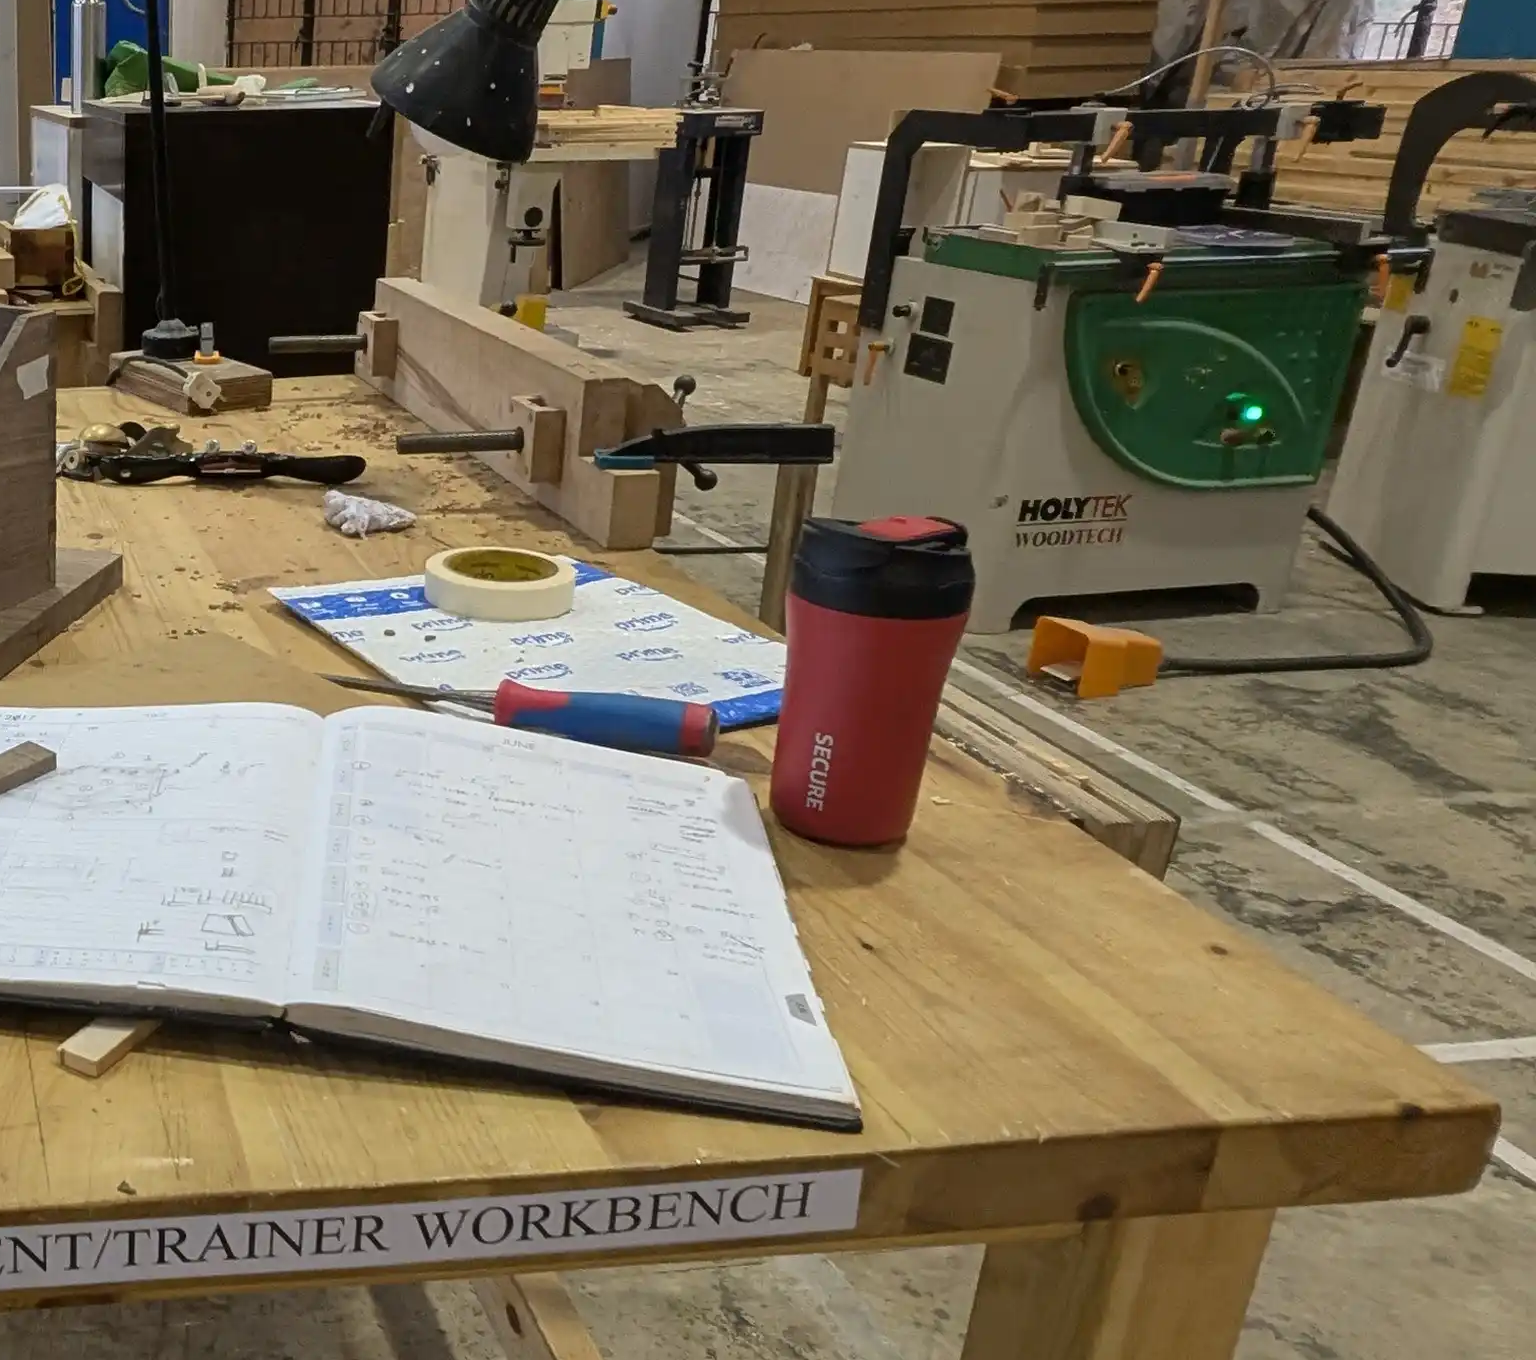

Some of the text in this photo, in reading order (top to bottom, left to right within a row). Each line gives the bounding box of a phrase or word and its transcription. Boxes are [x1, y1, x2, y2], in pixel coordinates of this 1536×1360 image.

[1018, 494, 1133, 522] HOLYTEK
[1015, 527, 1123, 548] WOODTECH
[614, 611, 674, 631] prime
[505, 662, 570, 680] prime
[501, 738, 536, 751] JUNE
[805, 731, 834, 812] SECURE
[412, 1180, 817, 1251] WORKBENCH
